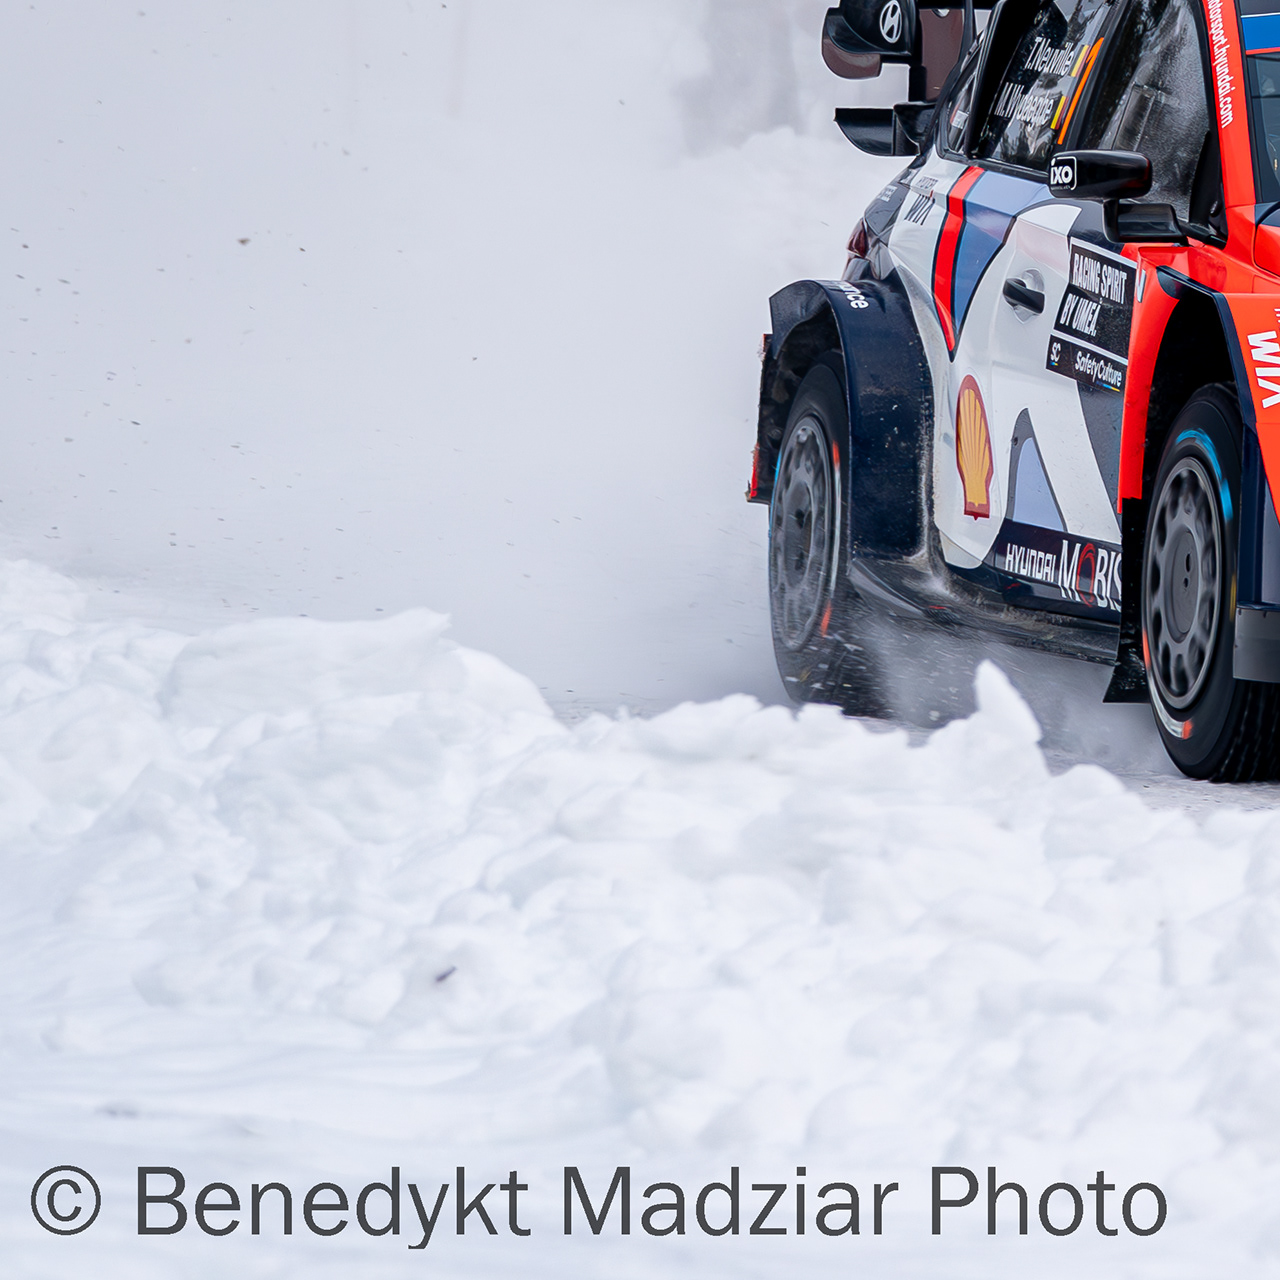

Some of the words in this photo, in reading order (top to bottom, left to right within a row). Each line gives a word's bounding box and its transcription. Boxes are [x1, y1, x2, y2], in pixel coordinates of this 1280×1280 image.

[1057, 36, 1104, 146] 1
[1072, 253, 1101, 295] RACING
[1101, 264, 1127, 305] SPIRIT
[1059, 293, 1079, 327] BY
[1050, 342, 1062, 363] SC
[1074, 350, 1123, 388] SafetyCulture
[1004, 542, 1057, 583] HYUNDAI
